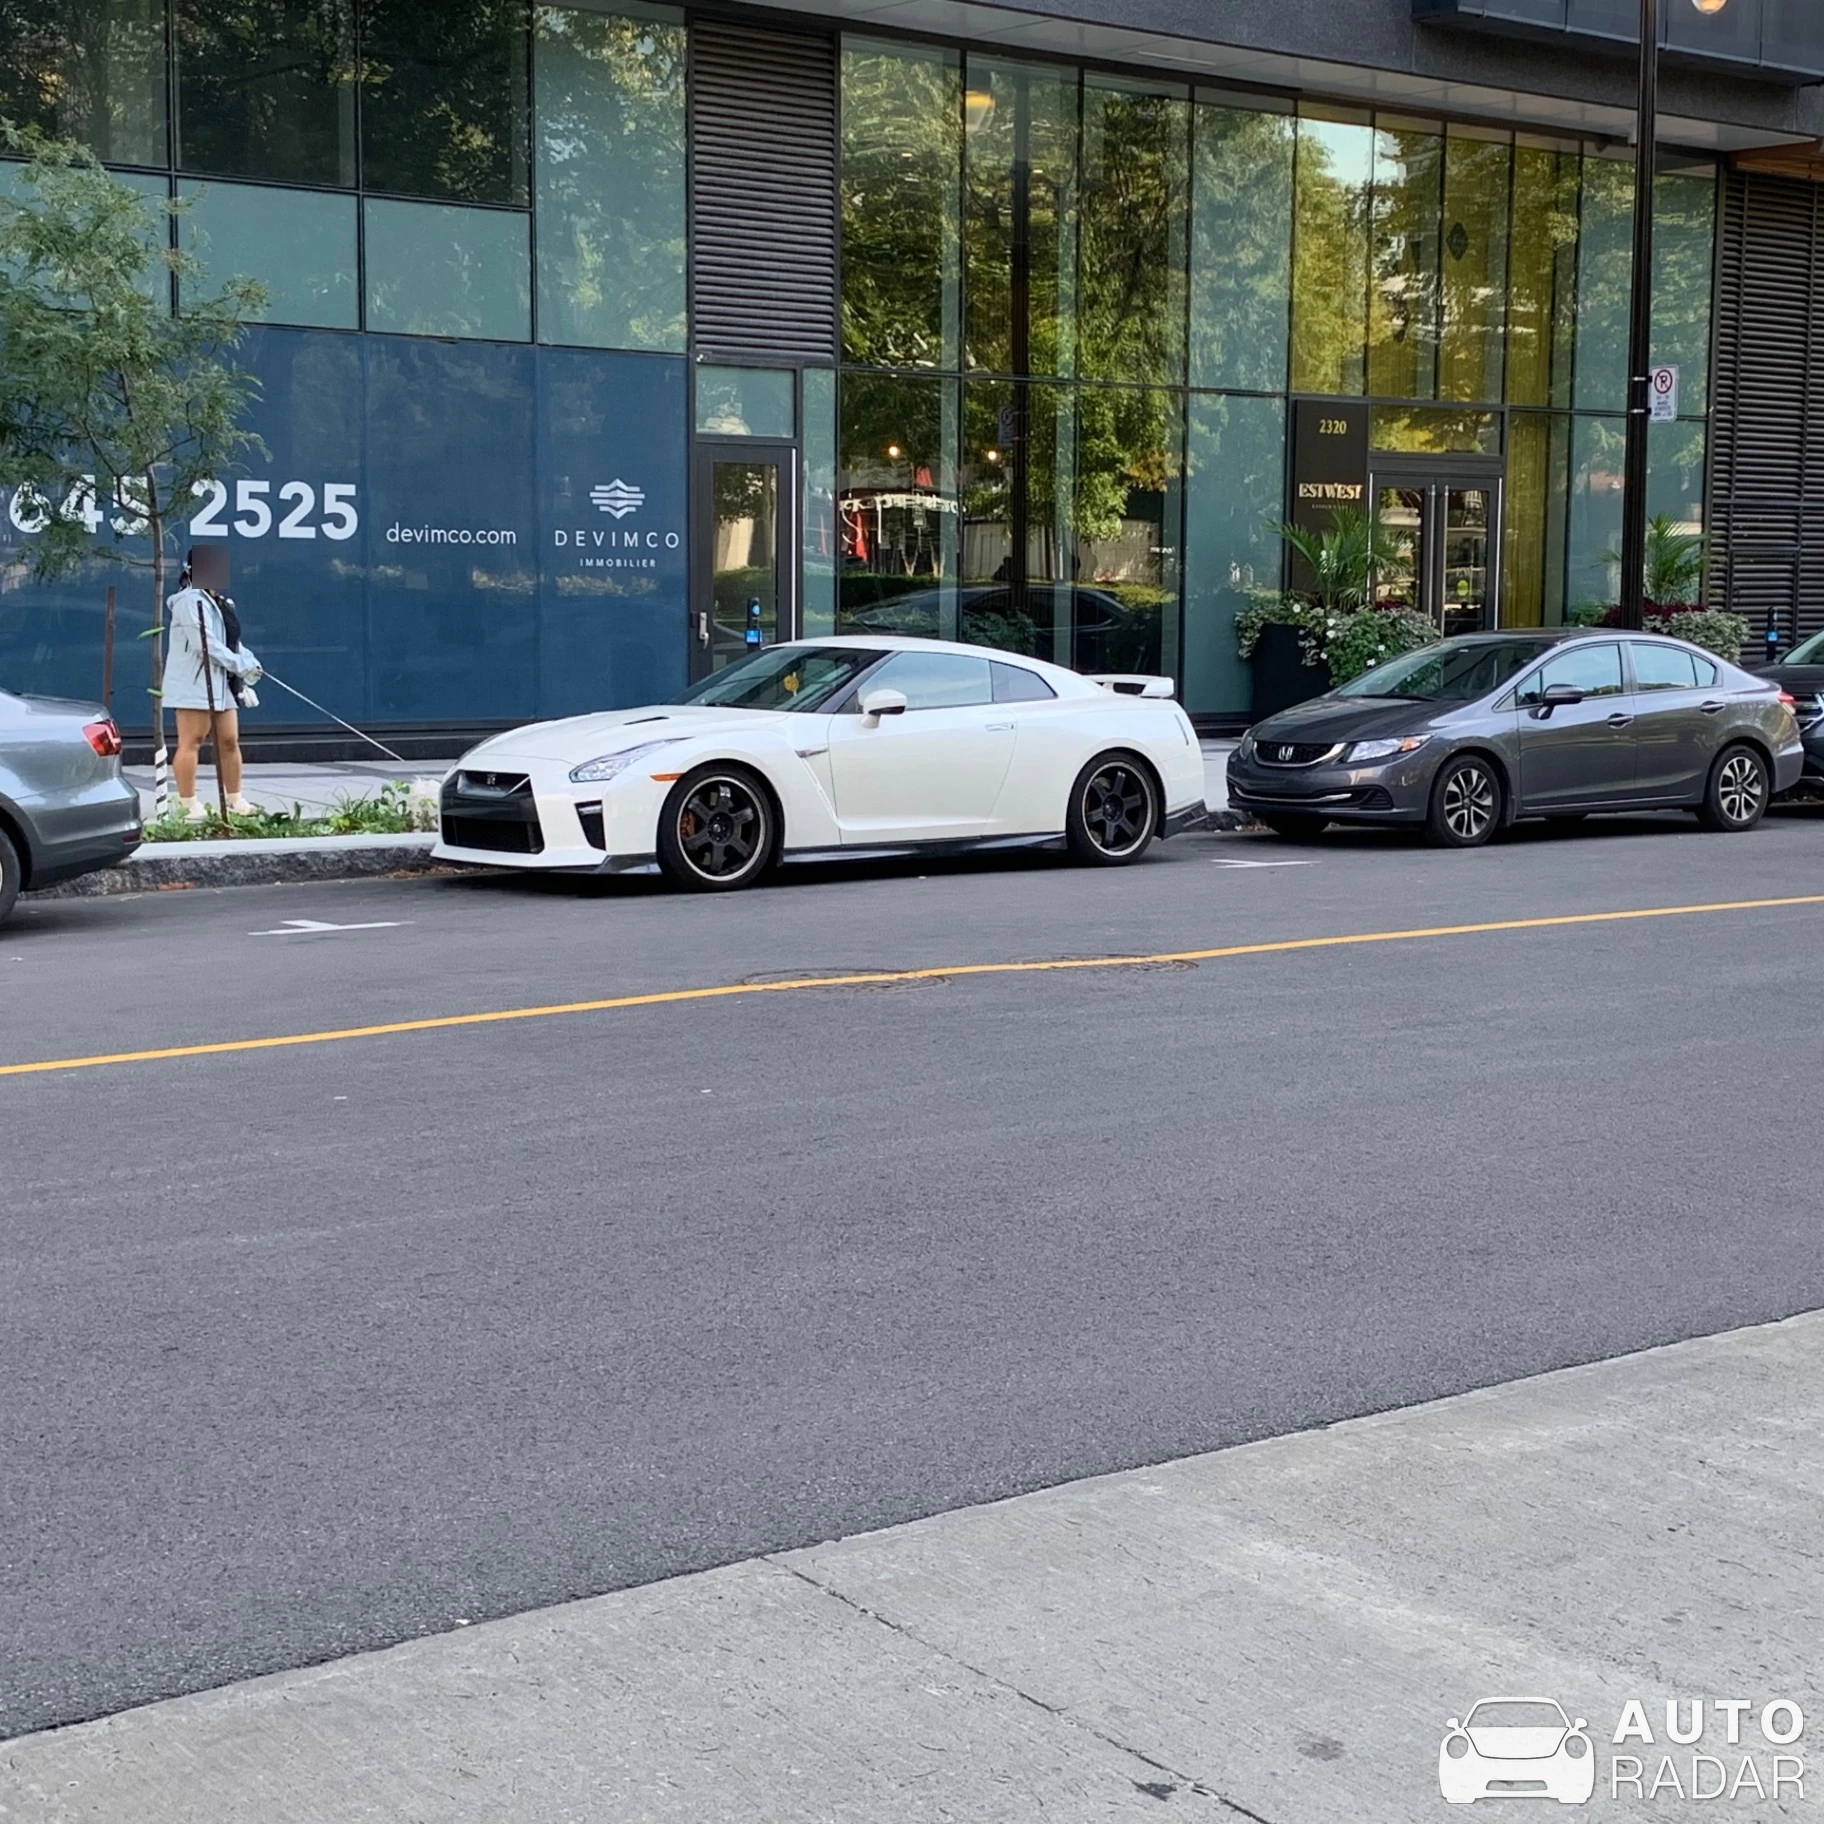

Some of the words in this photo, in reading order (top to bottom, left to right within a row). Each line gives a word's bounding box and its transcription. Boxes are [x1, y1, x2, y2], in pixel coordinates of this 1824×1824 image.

[1319, 419, 1347, 434] 2320
[9, 474, 152, 535] 645
[189, 478, 358, 541] 2525
[386, 522, 516, 544] devimco.com
[554, 530, 679, 548] DEVIMCO
[579, 558, 656, 567] IMMOBILIER
